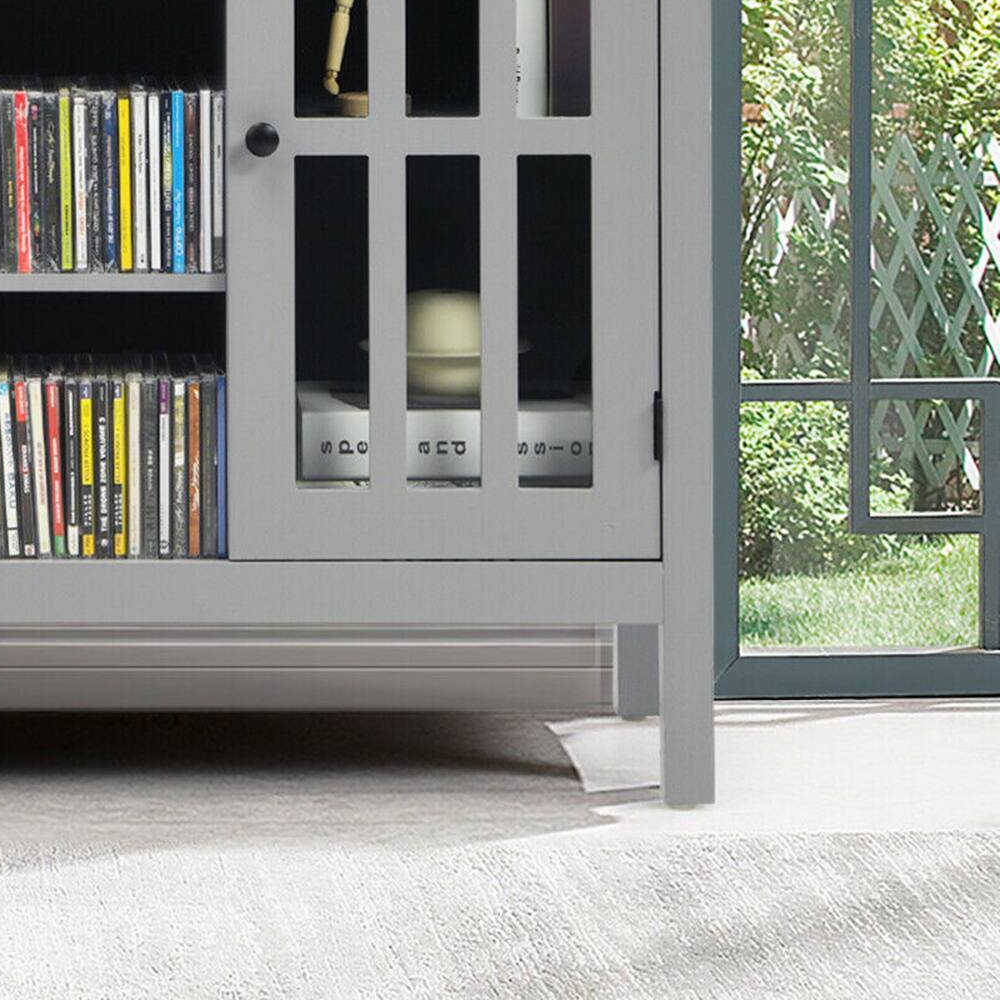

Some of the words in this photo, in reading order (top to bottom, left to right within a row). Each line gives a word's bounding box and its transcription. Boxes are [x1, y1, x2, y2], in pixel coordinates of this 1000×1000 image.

[99, 425, 107, 458] VOLUME
[320, 440, 369, 455] spe
[417, 440, 467, 456] and
[99, 461, 107, 483] ZONE
[99, 516, 108, 533] THE
